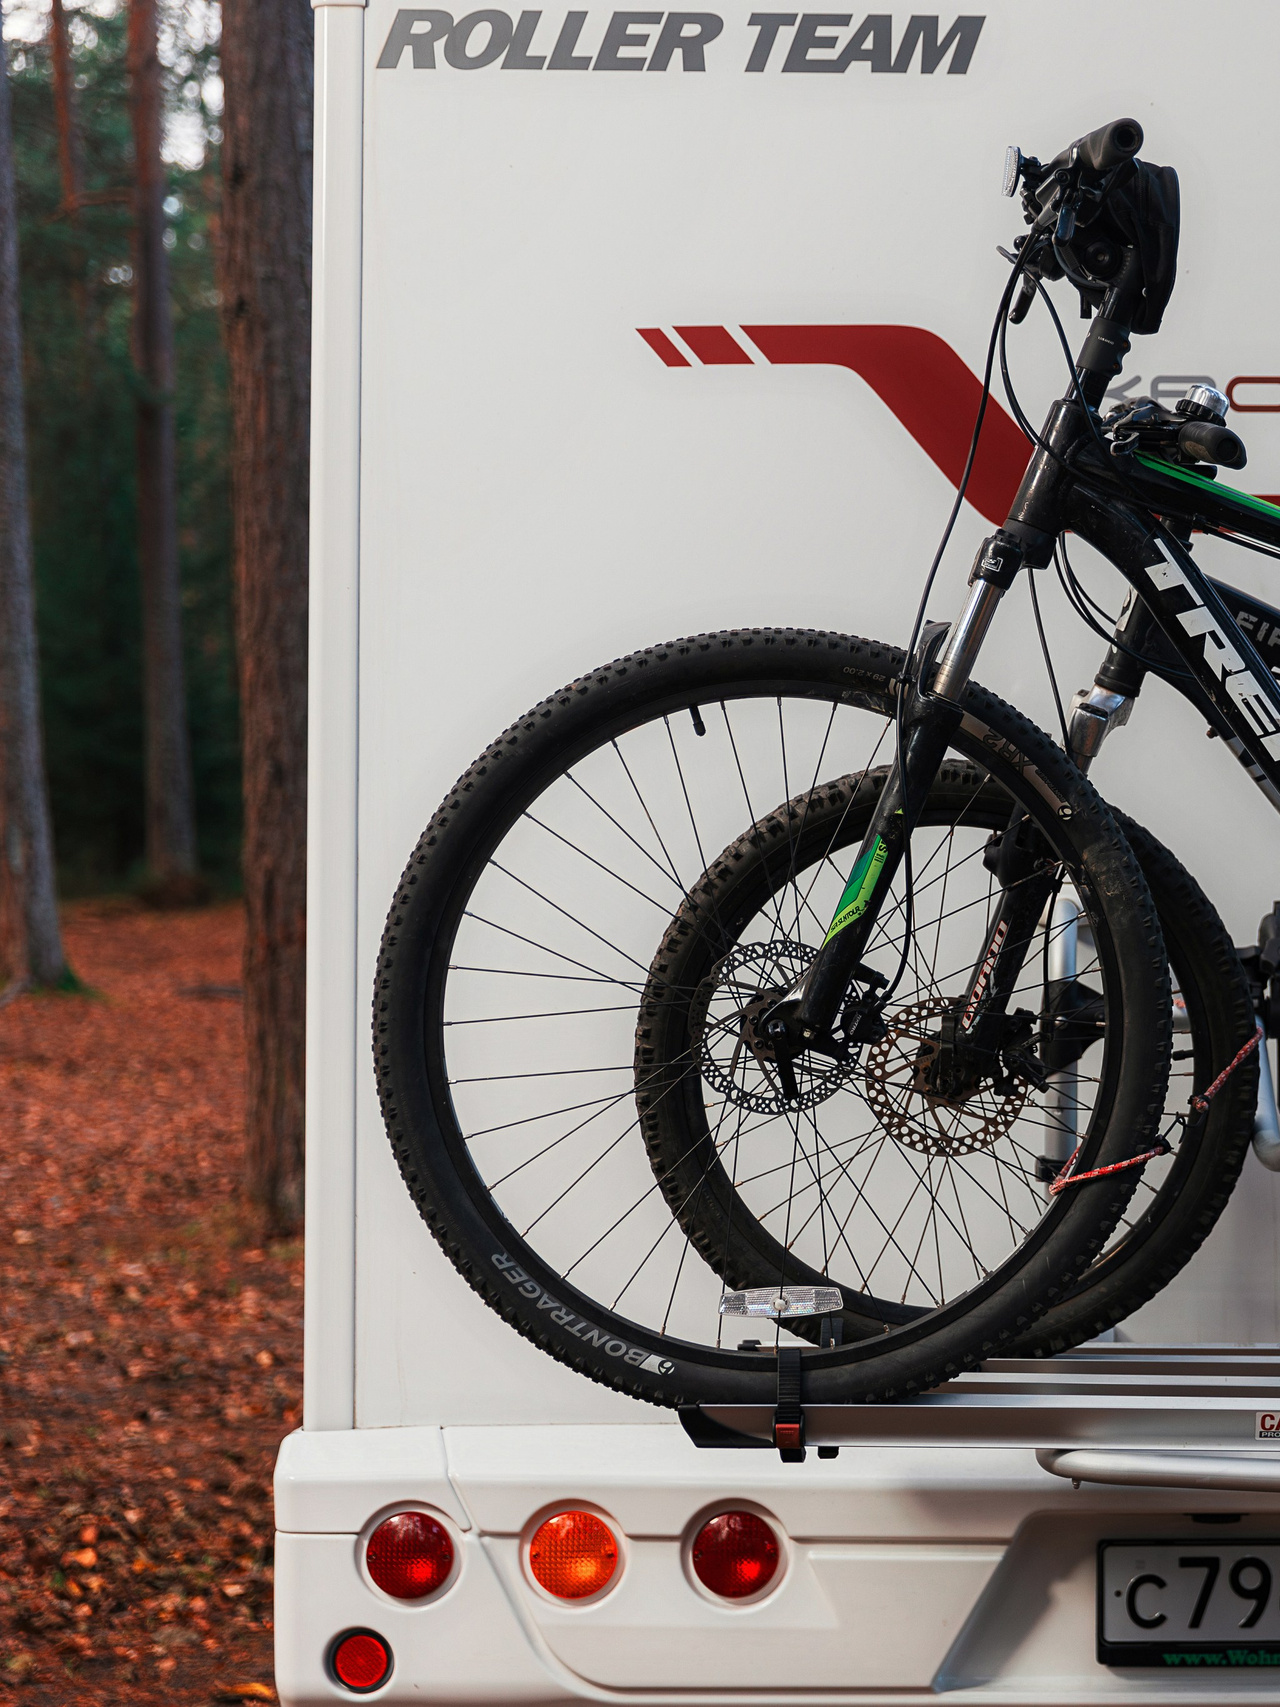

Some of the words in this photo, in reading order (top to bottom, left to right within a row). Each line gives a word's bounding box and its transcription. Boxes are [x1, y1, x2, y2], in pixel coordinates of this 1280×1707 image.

[376, 8, 724, 73] ROLLER
[744, 13, 986, 75] TEAM
[981, 727, 1035, 778] XR2
[961, 919, 1009, 1030] GORDO
[491, 1252, 651, 1367] BONTRAGER
